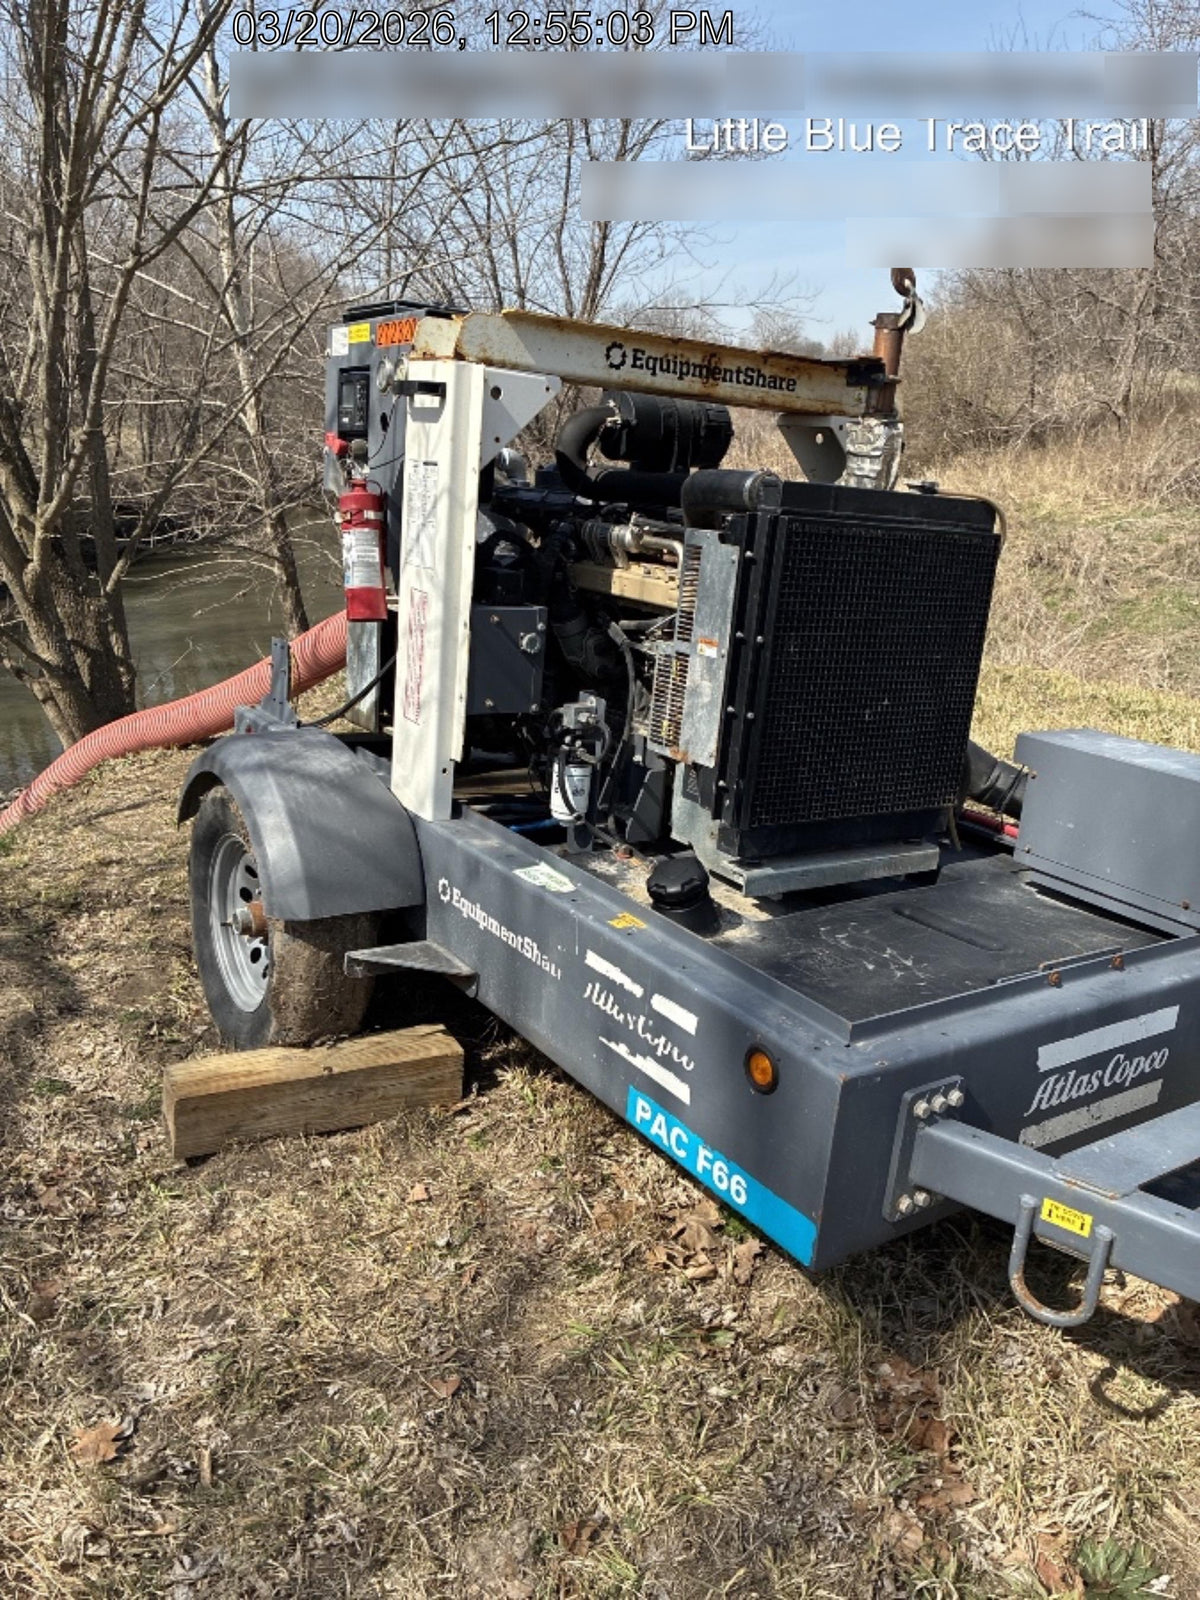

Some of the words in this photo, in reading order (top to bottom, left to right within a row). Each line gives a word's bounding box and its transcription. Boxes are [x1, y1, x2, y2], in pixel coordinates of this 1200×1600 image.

[631, 347, 798, 392] EquipmentShare
[635, 1096, 689, 1158] PAC
[696, 1144, 748, 1206] F66
